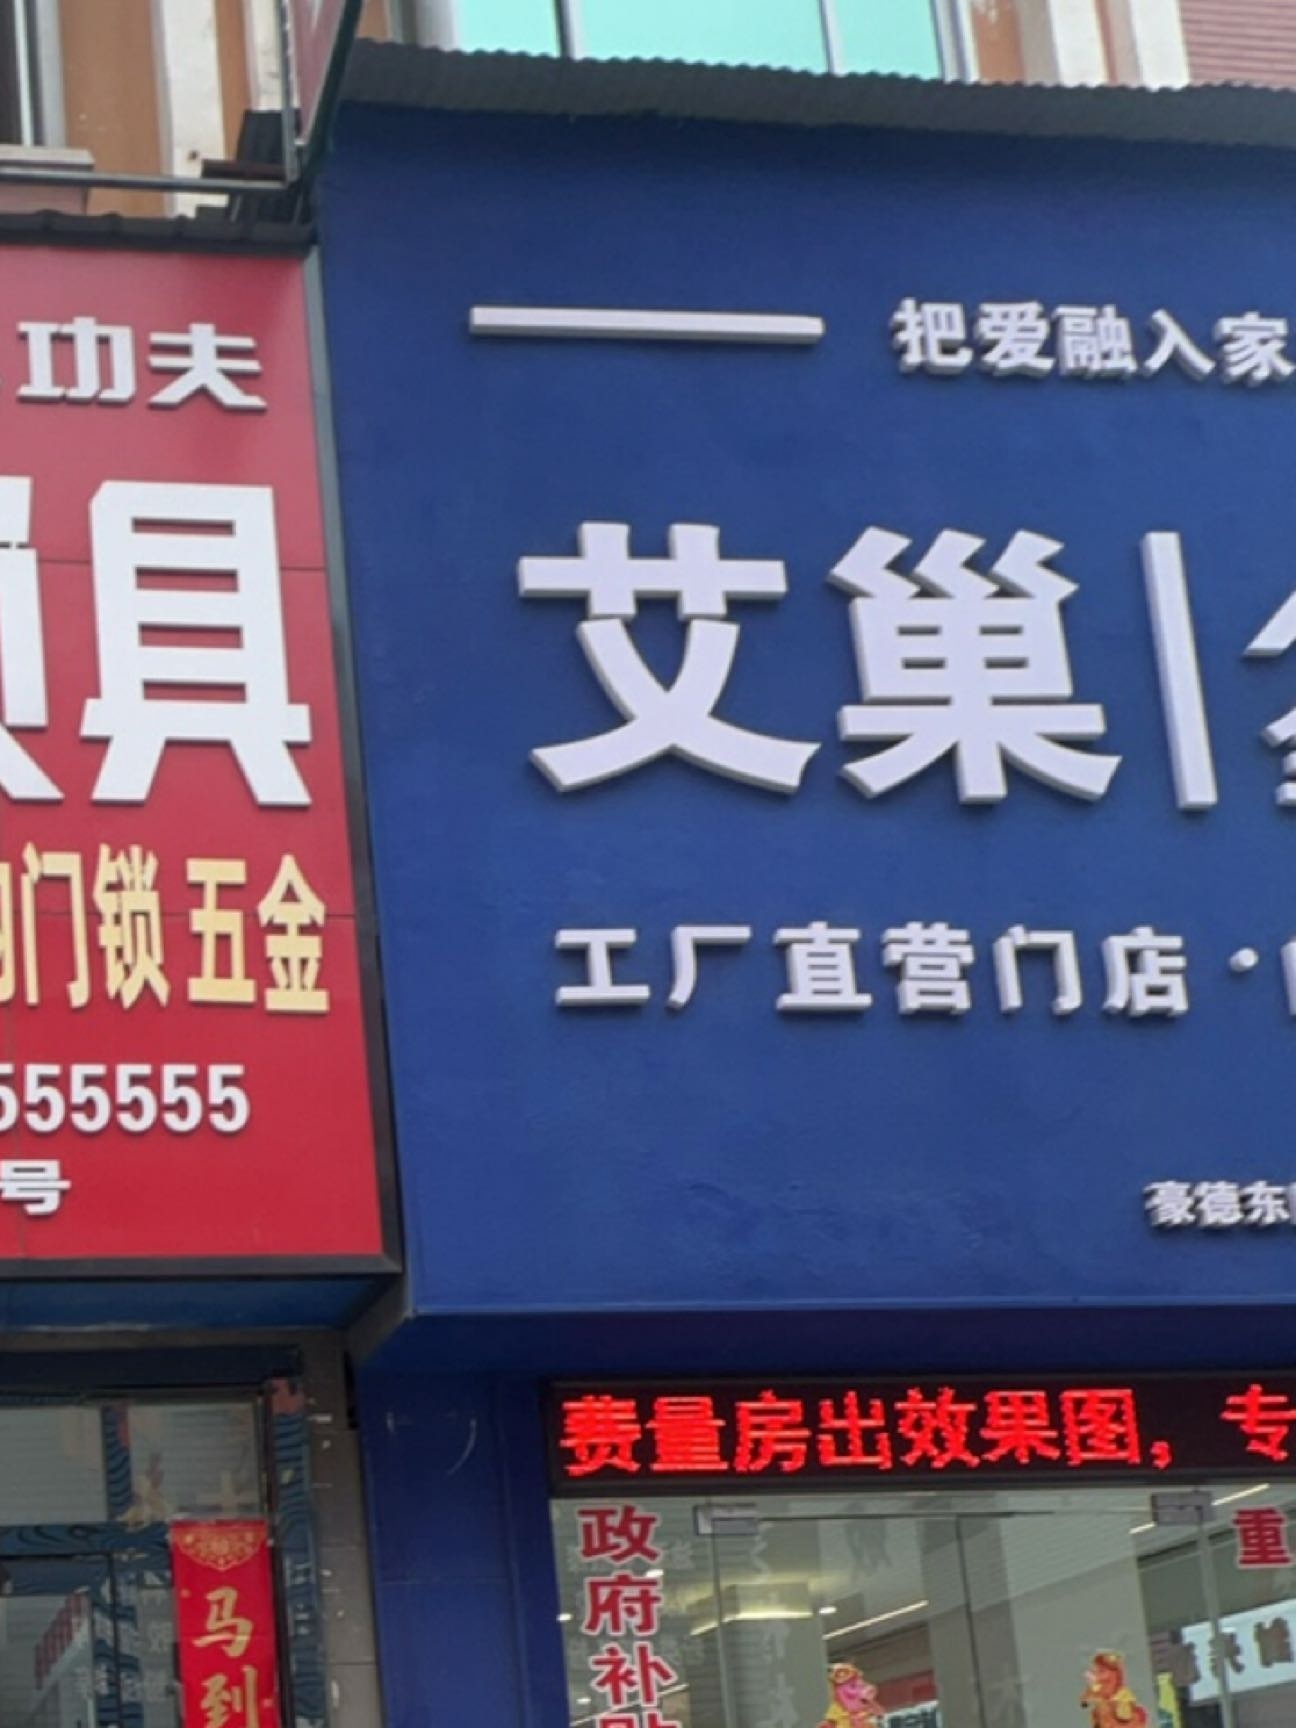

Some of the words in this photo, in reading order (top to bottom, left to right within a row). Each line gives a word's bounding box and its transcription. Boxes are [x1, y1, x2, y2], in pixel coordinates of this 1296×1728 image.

[890, 298, 1296, 384] 把爱融入家
[518, 522, 1122, 803] 艾巢
[186, 853, 330, 1014] 五金
[555, 921, 1296, 1015] 工厂直营门店·
[1144, 1180, 1296, 1227] 豪德东
